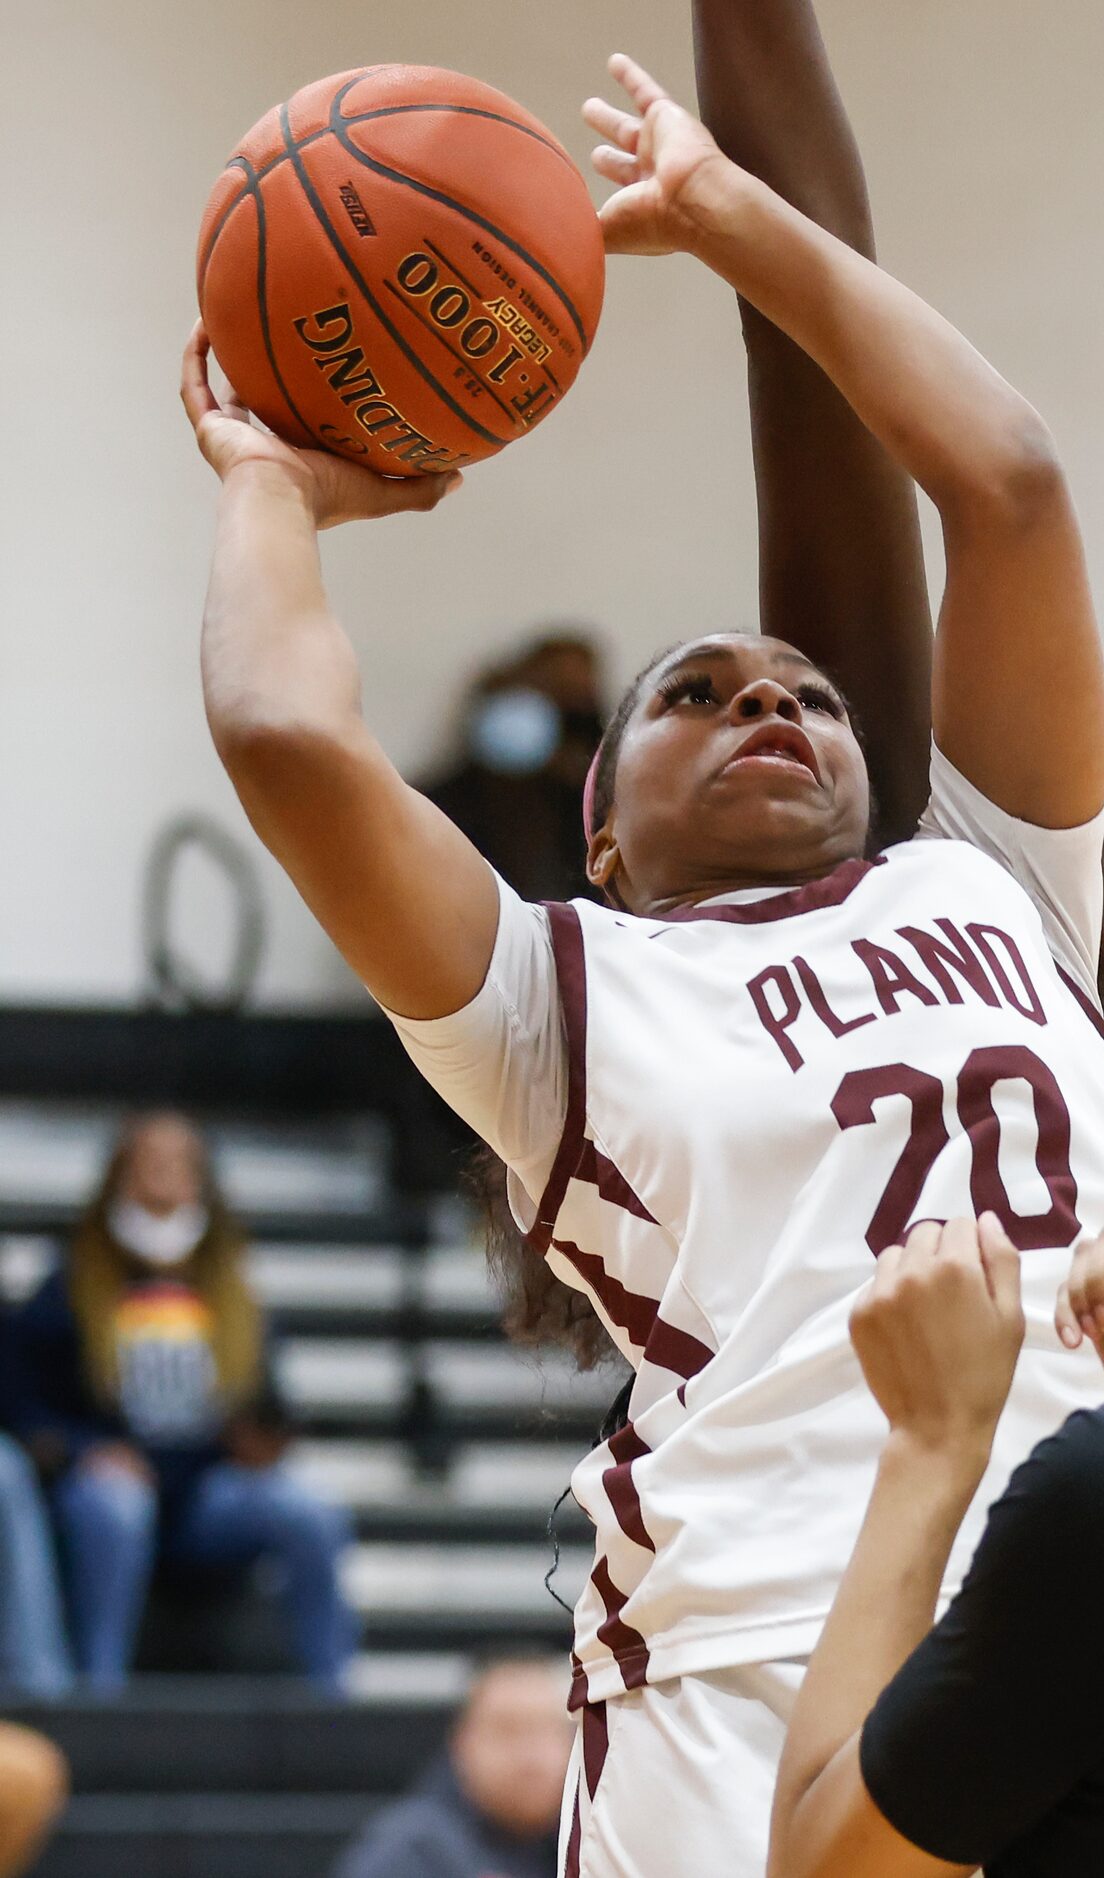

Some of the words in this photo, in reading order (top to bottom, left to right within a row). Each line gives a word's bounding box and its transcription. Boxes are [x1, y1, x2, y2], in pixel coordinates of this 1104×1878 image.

[471, 240, 517, 290] DESIGN
[482, 296, 552, 365] LEGACY
[292, 302, 471, 473] PALDING
[746, 918, 1048, 1074] PLANO
[830, 1045, 1082, 1259] 20
